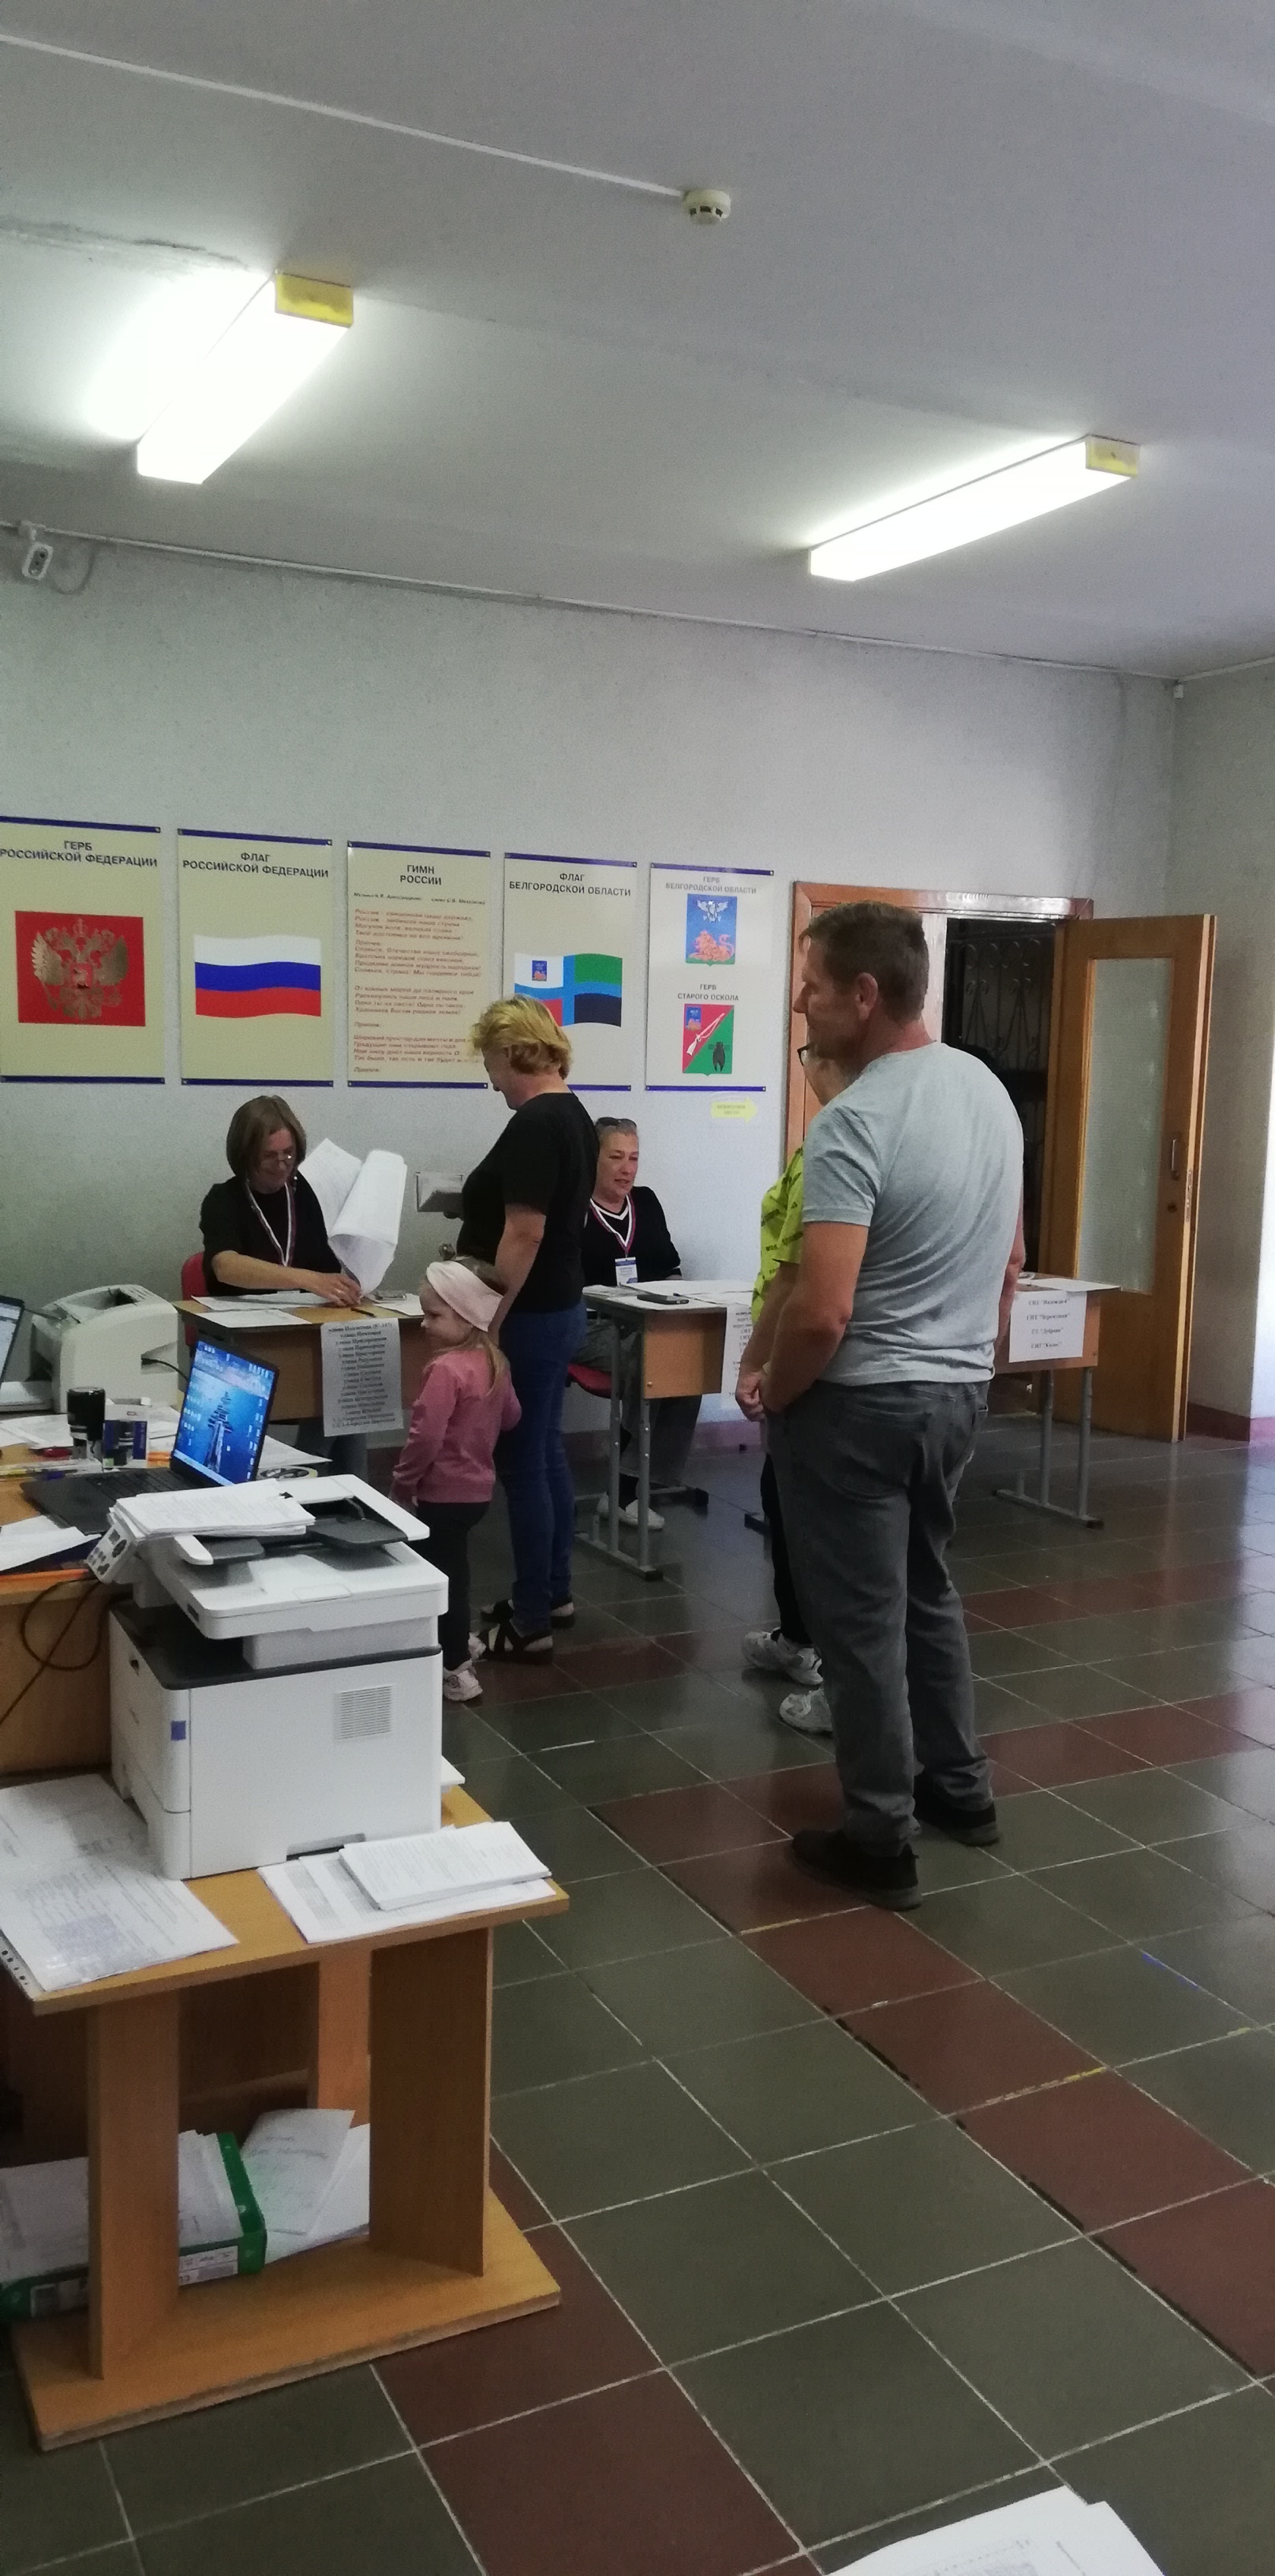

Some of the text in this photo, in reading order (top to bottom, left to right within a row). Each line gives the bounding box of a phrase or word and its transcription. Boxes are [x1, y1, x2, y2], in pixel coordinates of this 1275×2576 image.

[64, 841, 92, 851] ГЕРБ
[0, 848, 158, 867] РОССИЙСКОЙ ФЕДЕРАЦИИ
[241, 852, 271, 863] ФЛАГ
[182, 859, 329, 878] РОССИЙСКОЙ ФЕДЕРАЦИИ
[406, 864, 435, 874] ГИМН
[400, 874, 442, 886] РОССИИ
[559, 873, 585, 882] ФЛАГ
[509, 881, 631, 897] БЕЛГОРОДСКОЙ ОБЛАСТИ
[665, 882, 757, 894] БЕЛГОРОДСКОЙ ОБЛАСТИ
